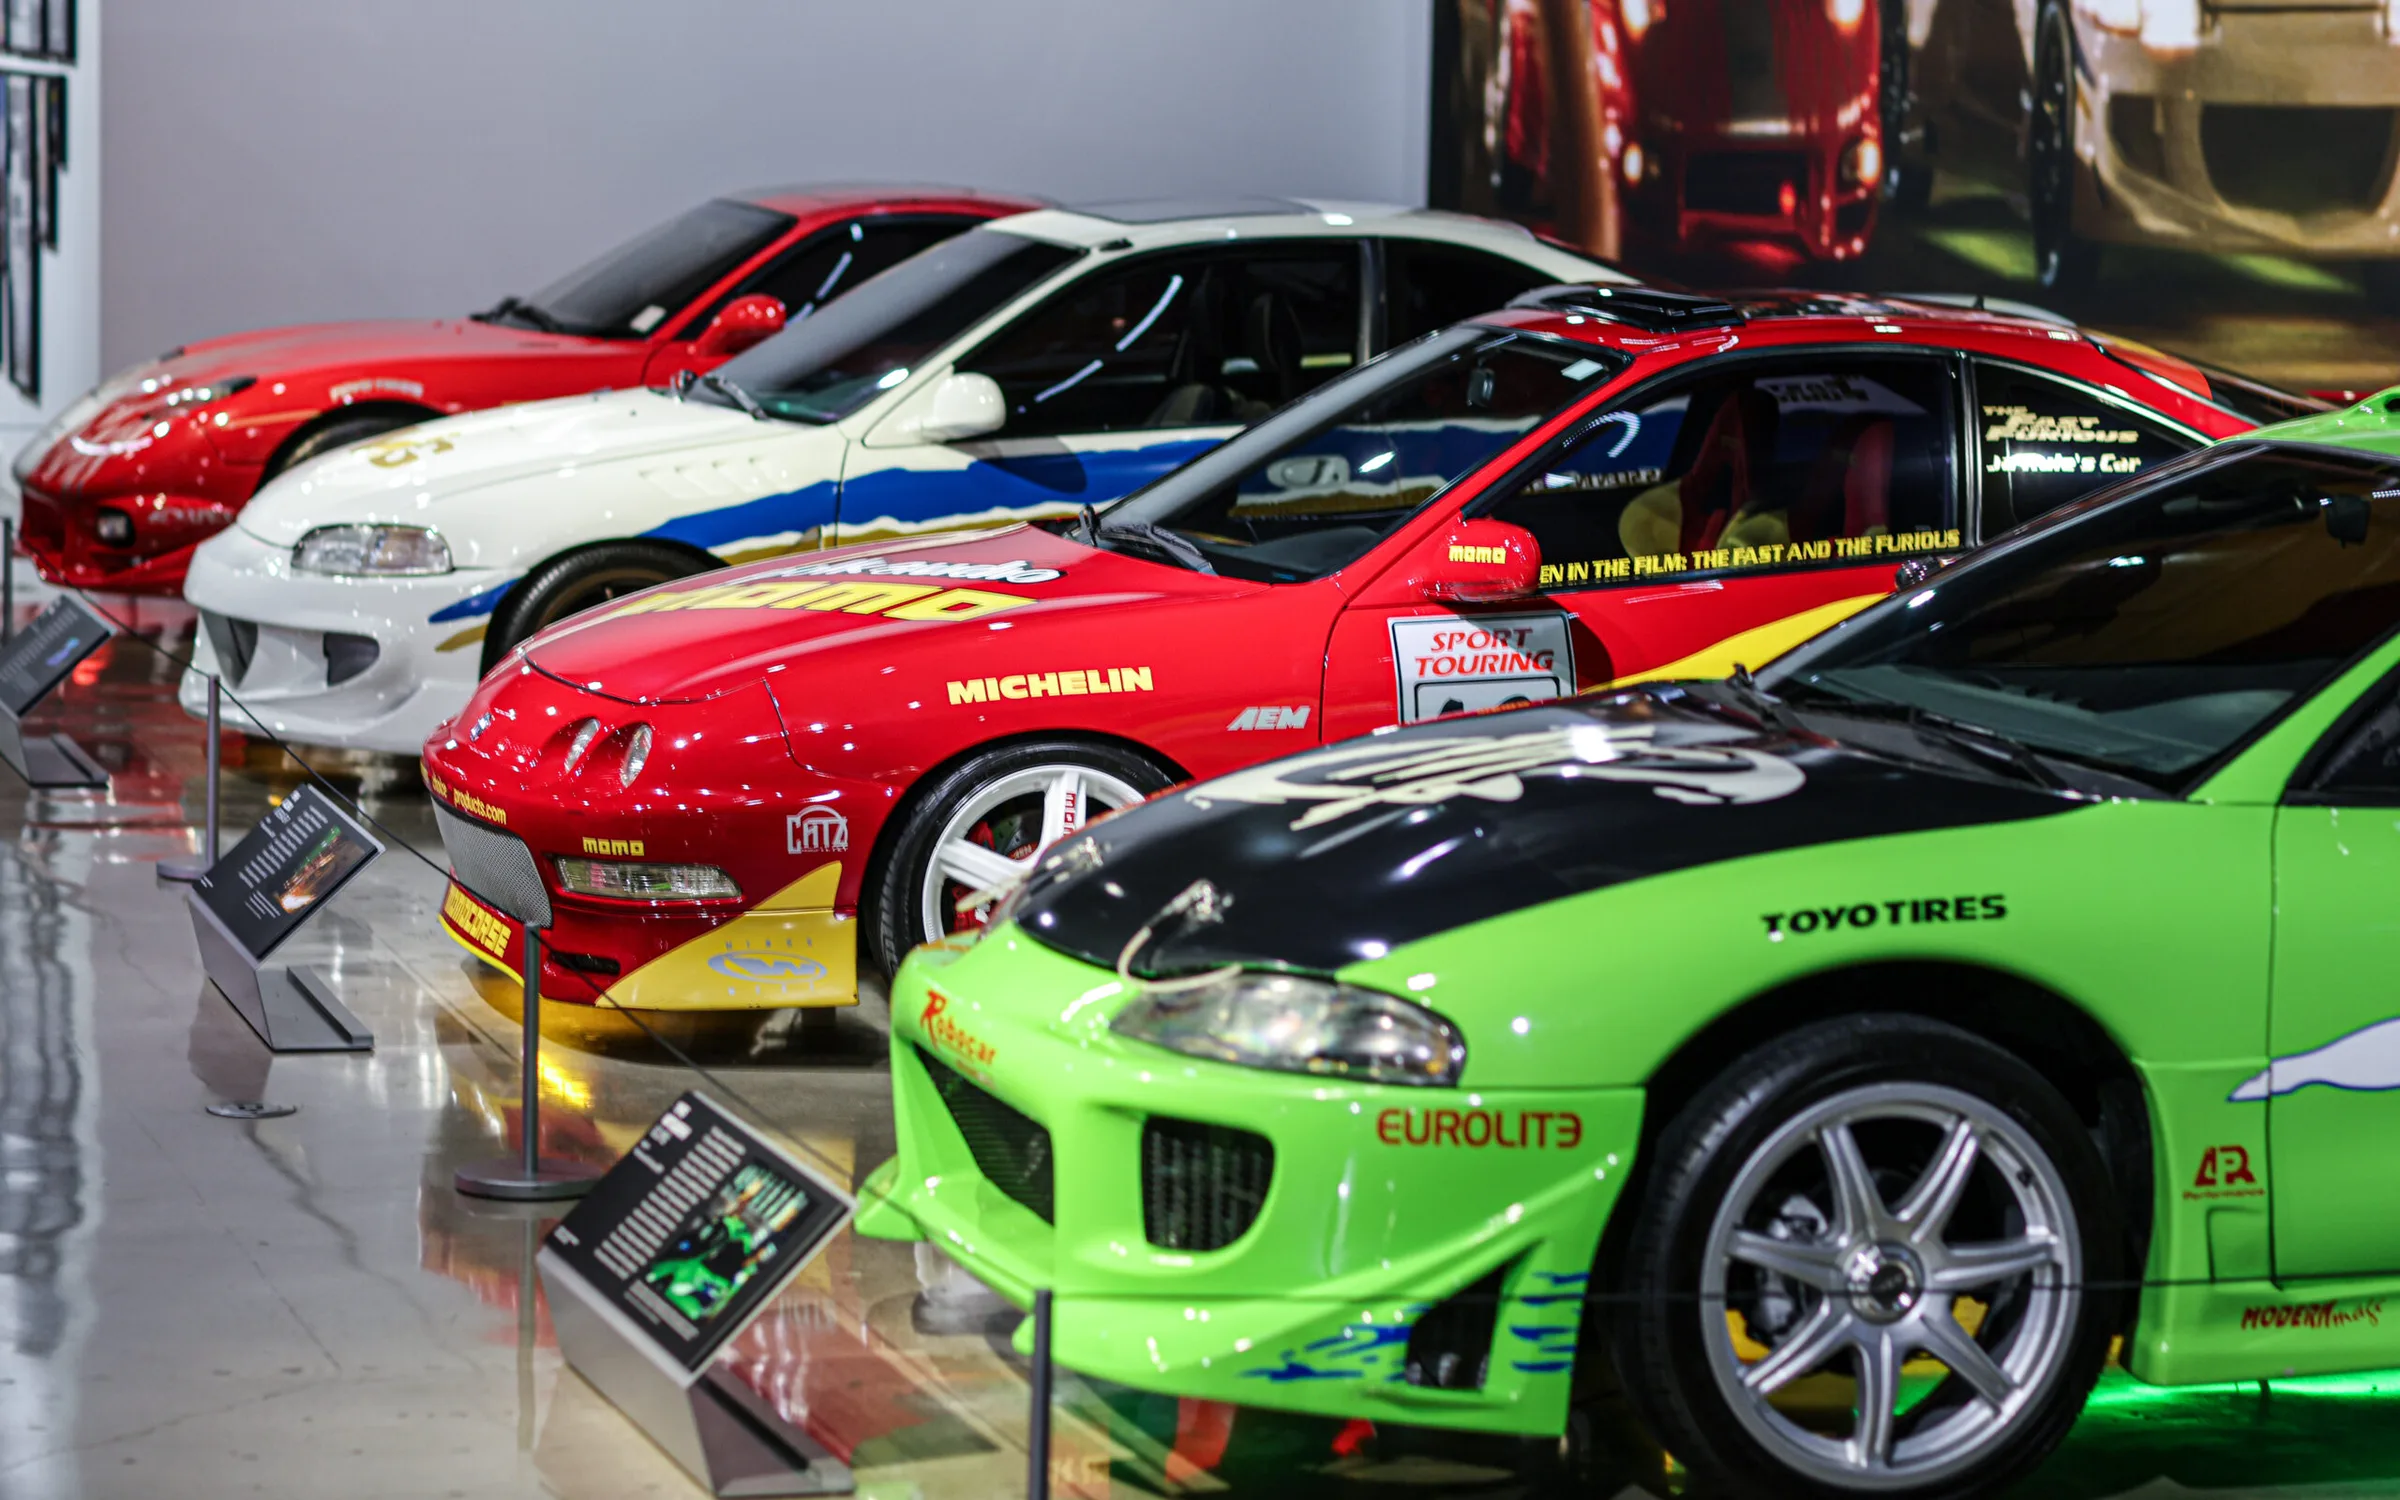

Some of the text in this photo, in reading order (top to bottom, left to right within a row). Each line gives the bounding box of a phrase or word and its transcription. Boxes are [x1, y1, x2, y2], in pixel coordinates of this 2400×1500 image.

[2100, 453, 2141, 472] Car
[1539, 528, 1960, 584] EN IN THE FILM: THE FAST AND THE FURIOUS
[1431, 626, 1532, 652] SPORT
[1415, 651, 1555, 678] TOURING
[946, 666, 1154, 705] MICHELIN
[1226, 705, 1310, 732] AEM
[786, 805, 849, 855] CATZ
[1760, 893, 2009, 936] TOYO TIRES
